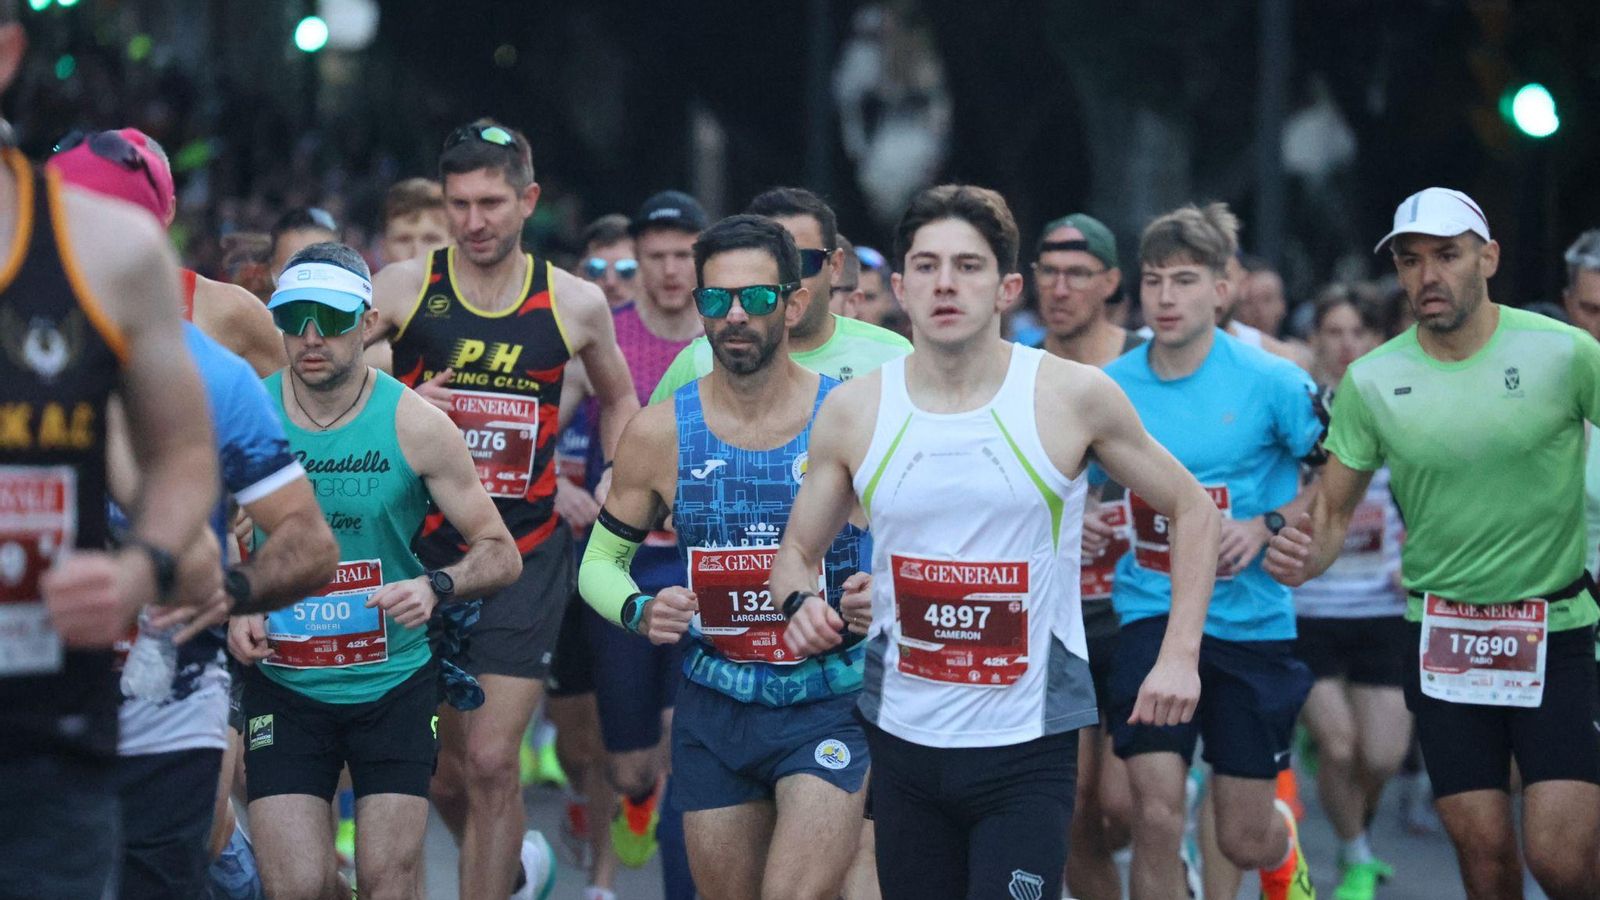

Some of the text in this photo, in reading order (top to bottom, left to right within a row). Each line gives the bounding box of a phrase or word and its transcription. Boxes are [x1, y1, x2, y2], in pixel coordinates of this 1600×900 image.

[456, 397, 529, 418] GENERALI
[460, 428, 506, 451] 076
[725, 554, 776, 571] GENE
[332, 565, 373, 584] RALI
[924, 564, 1019, 585] GENERALI
[728, 590, 775, 612] 132
[293, 602, 351, 621] 5700
[731, 613, 787, 622] LARGARSSO
[924, 603, 991, 629] 4897
[346, 639, 369, 648] 42K
[934, 629, 981, 640] CAMERON
[1449, 634, 1518, 657] 17690
[982, 656, 1008, 667] 42K
[1470, 656, 1493, 665] FABIO
